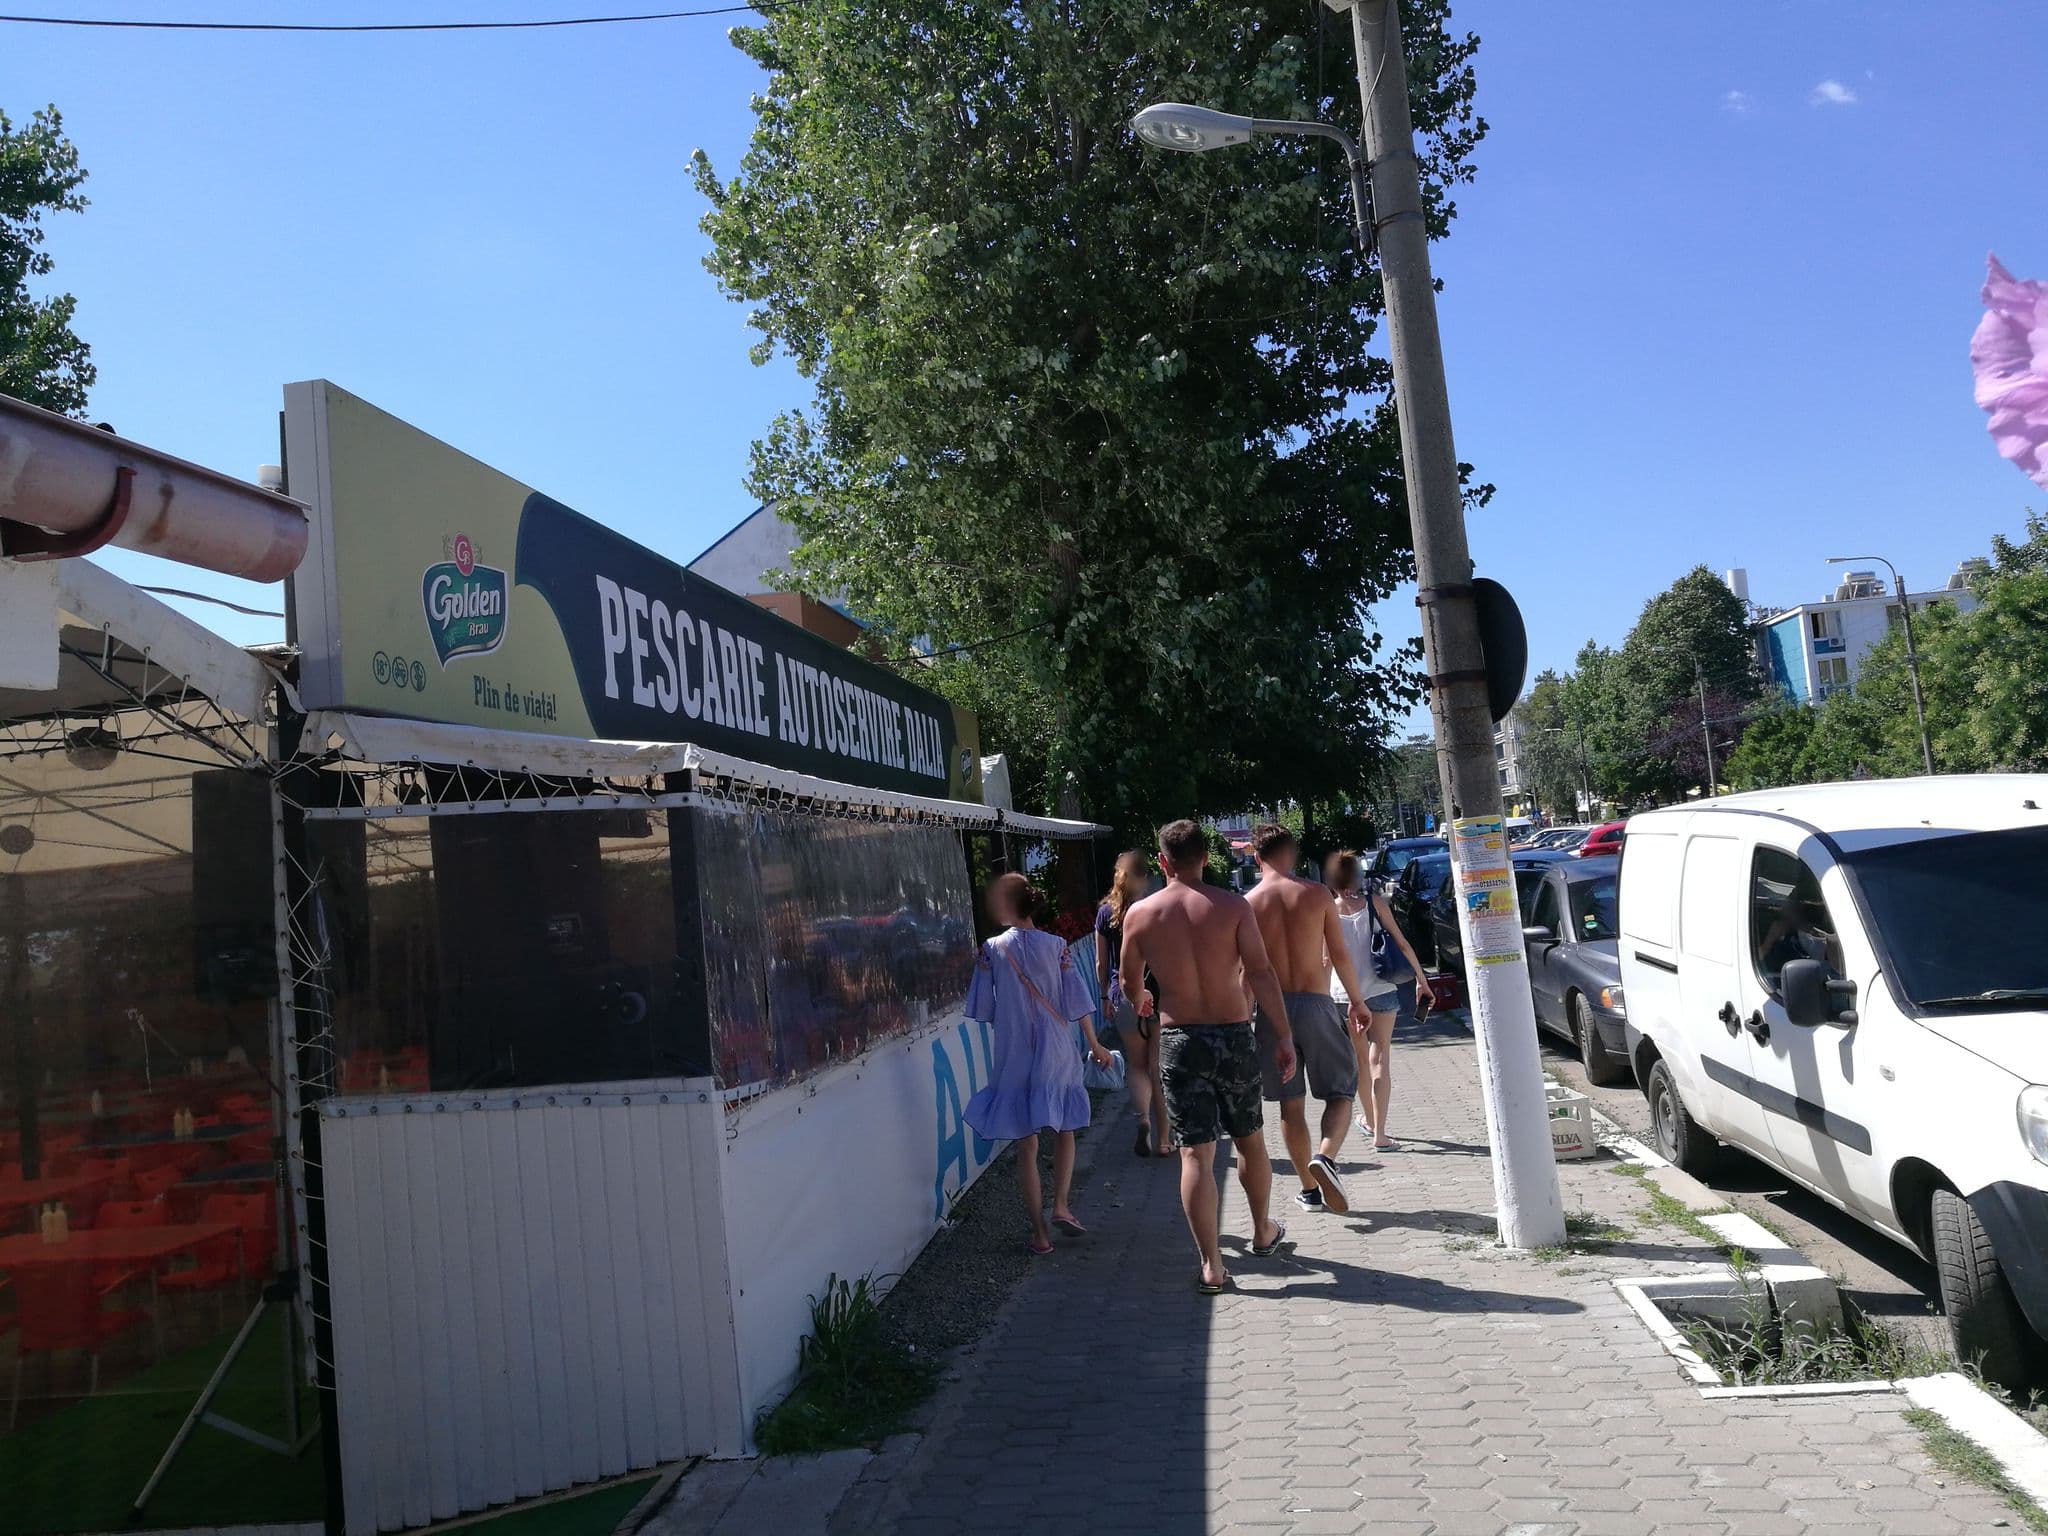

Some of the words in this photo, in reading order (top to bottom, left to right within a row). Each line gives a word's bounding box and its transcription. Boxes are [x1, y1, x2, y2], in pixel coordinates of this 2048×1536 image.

[429, 575, 500, 630] Golden
[467, 622, 489, 637] Brau
[473, 674, 501, 711] Plin
[504, 683, 520, 713] de
[596, 574, 771, 737] PESCARIE
[775, 651, 905, 769] AUTOSERVIRE
[903, 706, 946, 780] DALIA
[1551, 1132, 1582, 1145] SILVA
